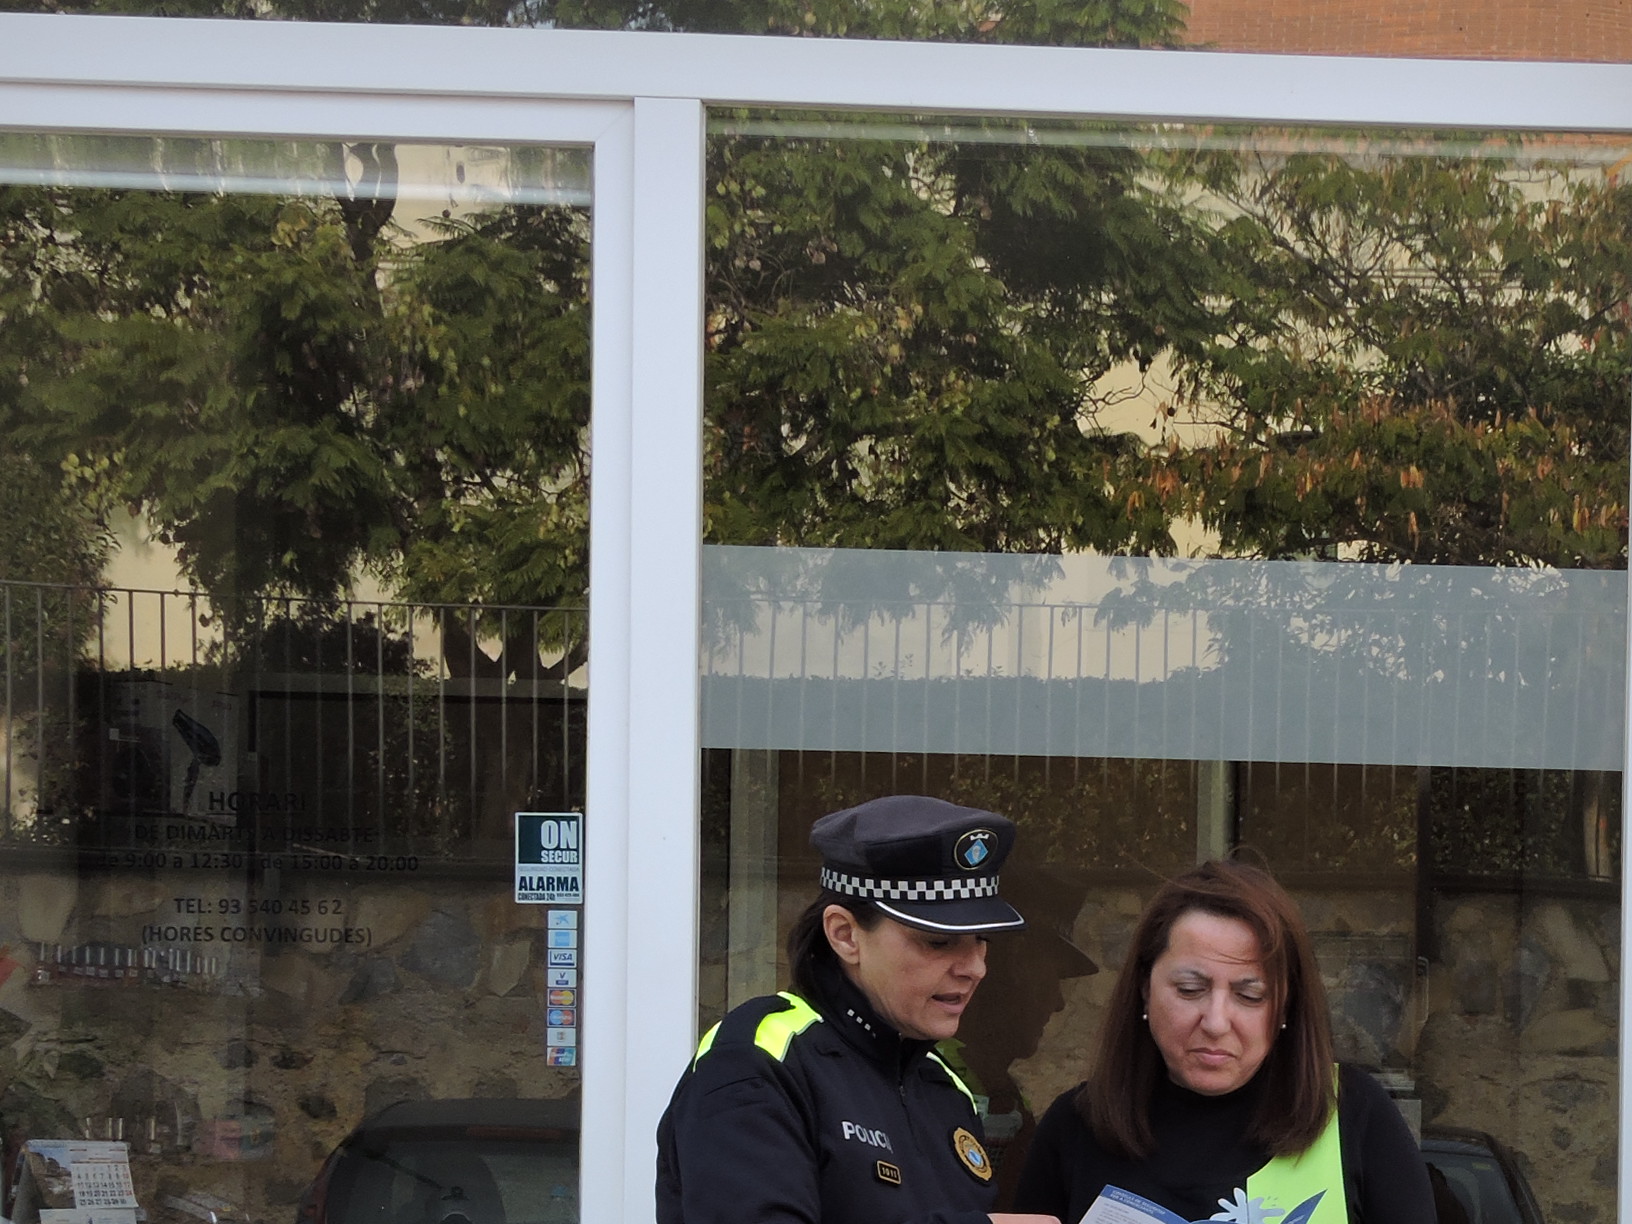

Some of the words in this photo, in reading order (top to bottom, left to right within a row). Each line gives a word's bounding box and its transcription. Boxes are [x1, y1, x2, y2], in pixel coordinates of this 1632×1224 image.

[208, 790, 305, 812] HORARI
[135, 825, 159, 840] DE
[541, 820, 577, 849] ON
[126, 853, 166, 869] 9:00
[190, 853, 243, 870] 12:30
[291, 854, 343, 871] 15:00
[366, 855, 418, 872] 20:00
[541, 850, 577, 863] SECUR
[519, 876, 579, 891] ALARMA
[173, 897, 212, 914] TEL:
[218, 898, 241, 915] 93
[247, 898, 283, 915] 540
[288, 899, 311, 915] 45
[142, 925, 215, 945] (HORES
[219, 925, 372, 948] CONVINGUDES)
[553, 953, 573, 961] VISA
